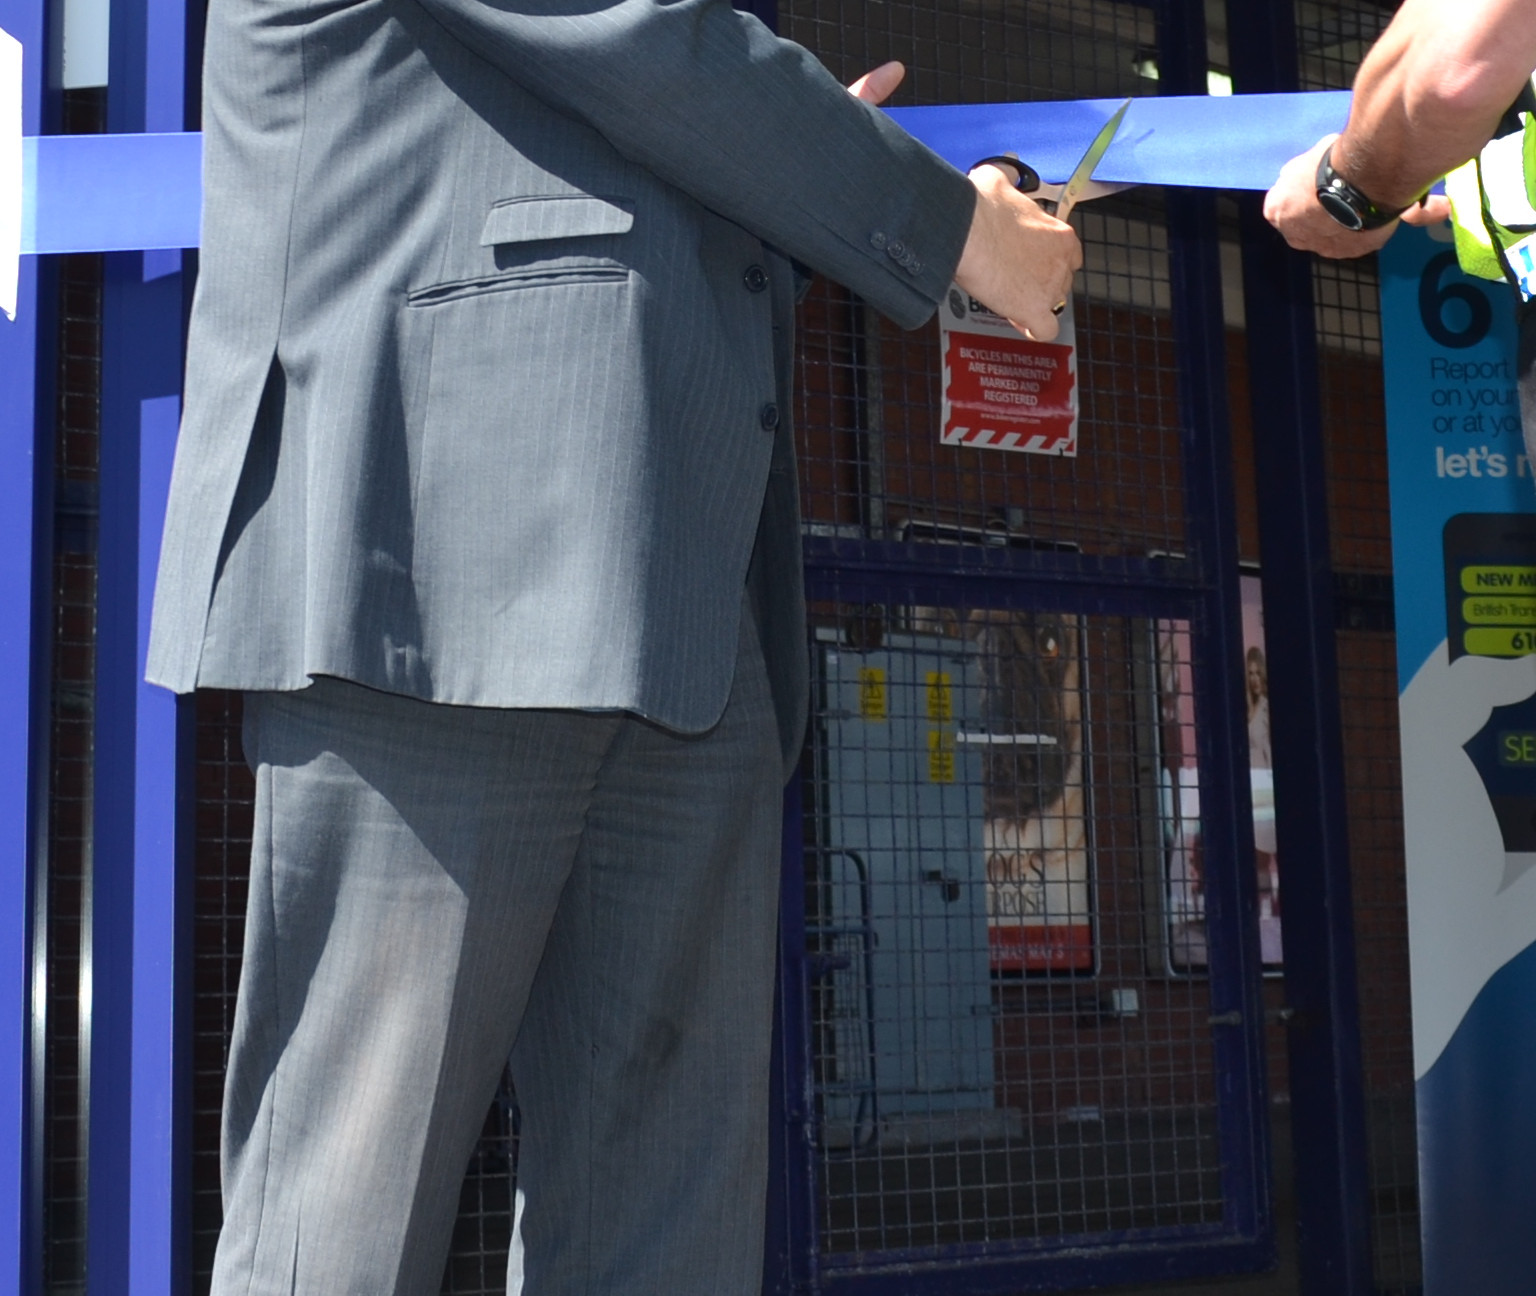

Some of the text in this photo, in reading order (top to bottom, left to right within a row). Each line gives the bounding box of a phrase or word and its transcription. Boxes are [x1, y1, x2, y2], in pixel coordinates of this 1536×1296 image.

[959, 347, 1058, 369] BICYCLES IN THIS AREA
[968, 361, 1052, 381] ARE PERMANENTLY
[1431, 357, 1508, 384] Report
[980, 376, 1040, 393] MARKED AND
[984, 389, 1038, 406] REGISTERED
[1432, 389, 1462, 407] on
[1434, 412, 1521, 438] or at yo
[1476, 572, 1514, 588] NEW
[1473, 604, 1508, 618] British
